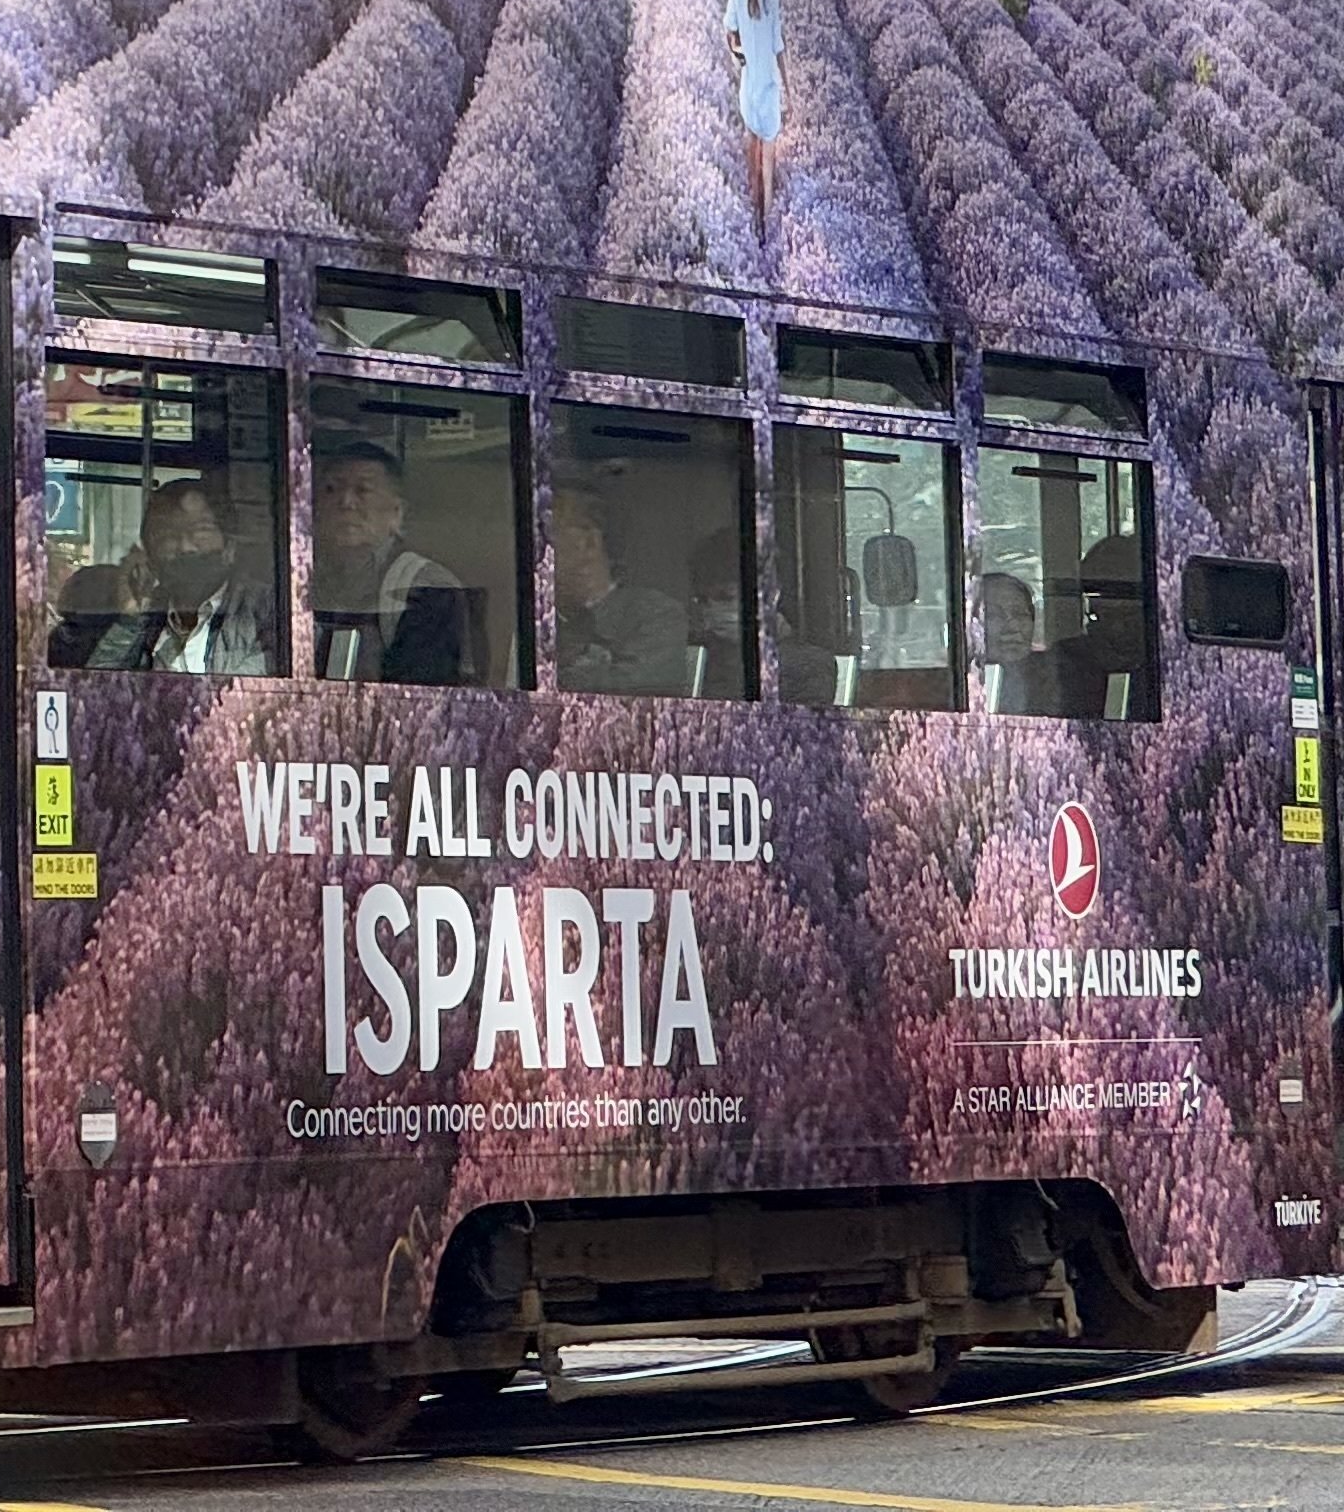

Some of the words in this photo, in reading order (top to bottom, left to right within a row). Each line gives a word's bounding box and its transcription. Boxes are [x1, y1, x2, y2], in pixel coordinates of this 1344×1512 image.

[39, 815, 69, 835] EXIT
[237, 761, 392, 856] WE'RE
[406, 767, 492, 859] ALL
[506, 770, 774, 864] CONNECTED:
[322, 884, 718, 1076] ISPARTA
[949, 949, 1073, 999] TURKISH
[1081, 949, 1202, 998] AIRLINES
[287, 1099, 421, 1141] Connecting
[427, 1102, 486, 1132] more
[491, 1093, 590, 1129] countries
[594, 1092, 643, 1127] than
[648, 1097, 682, 1132] any
[688, 1089, 747, 1126] other.
[953, 1089, 965, 1114] A
[968, 1086, 1011, 1113] STAR
[1015, 1084, 1095, 1112] ALLIANCE
[1099, 1081, 1171, 1108] MEMBER
